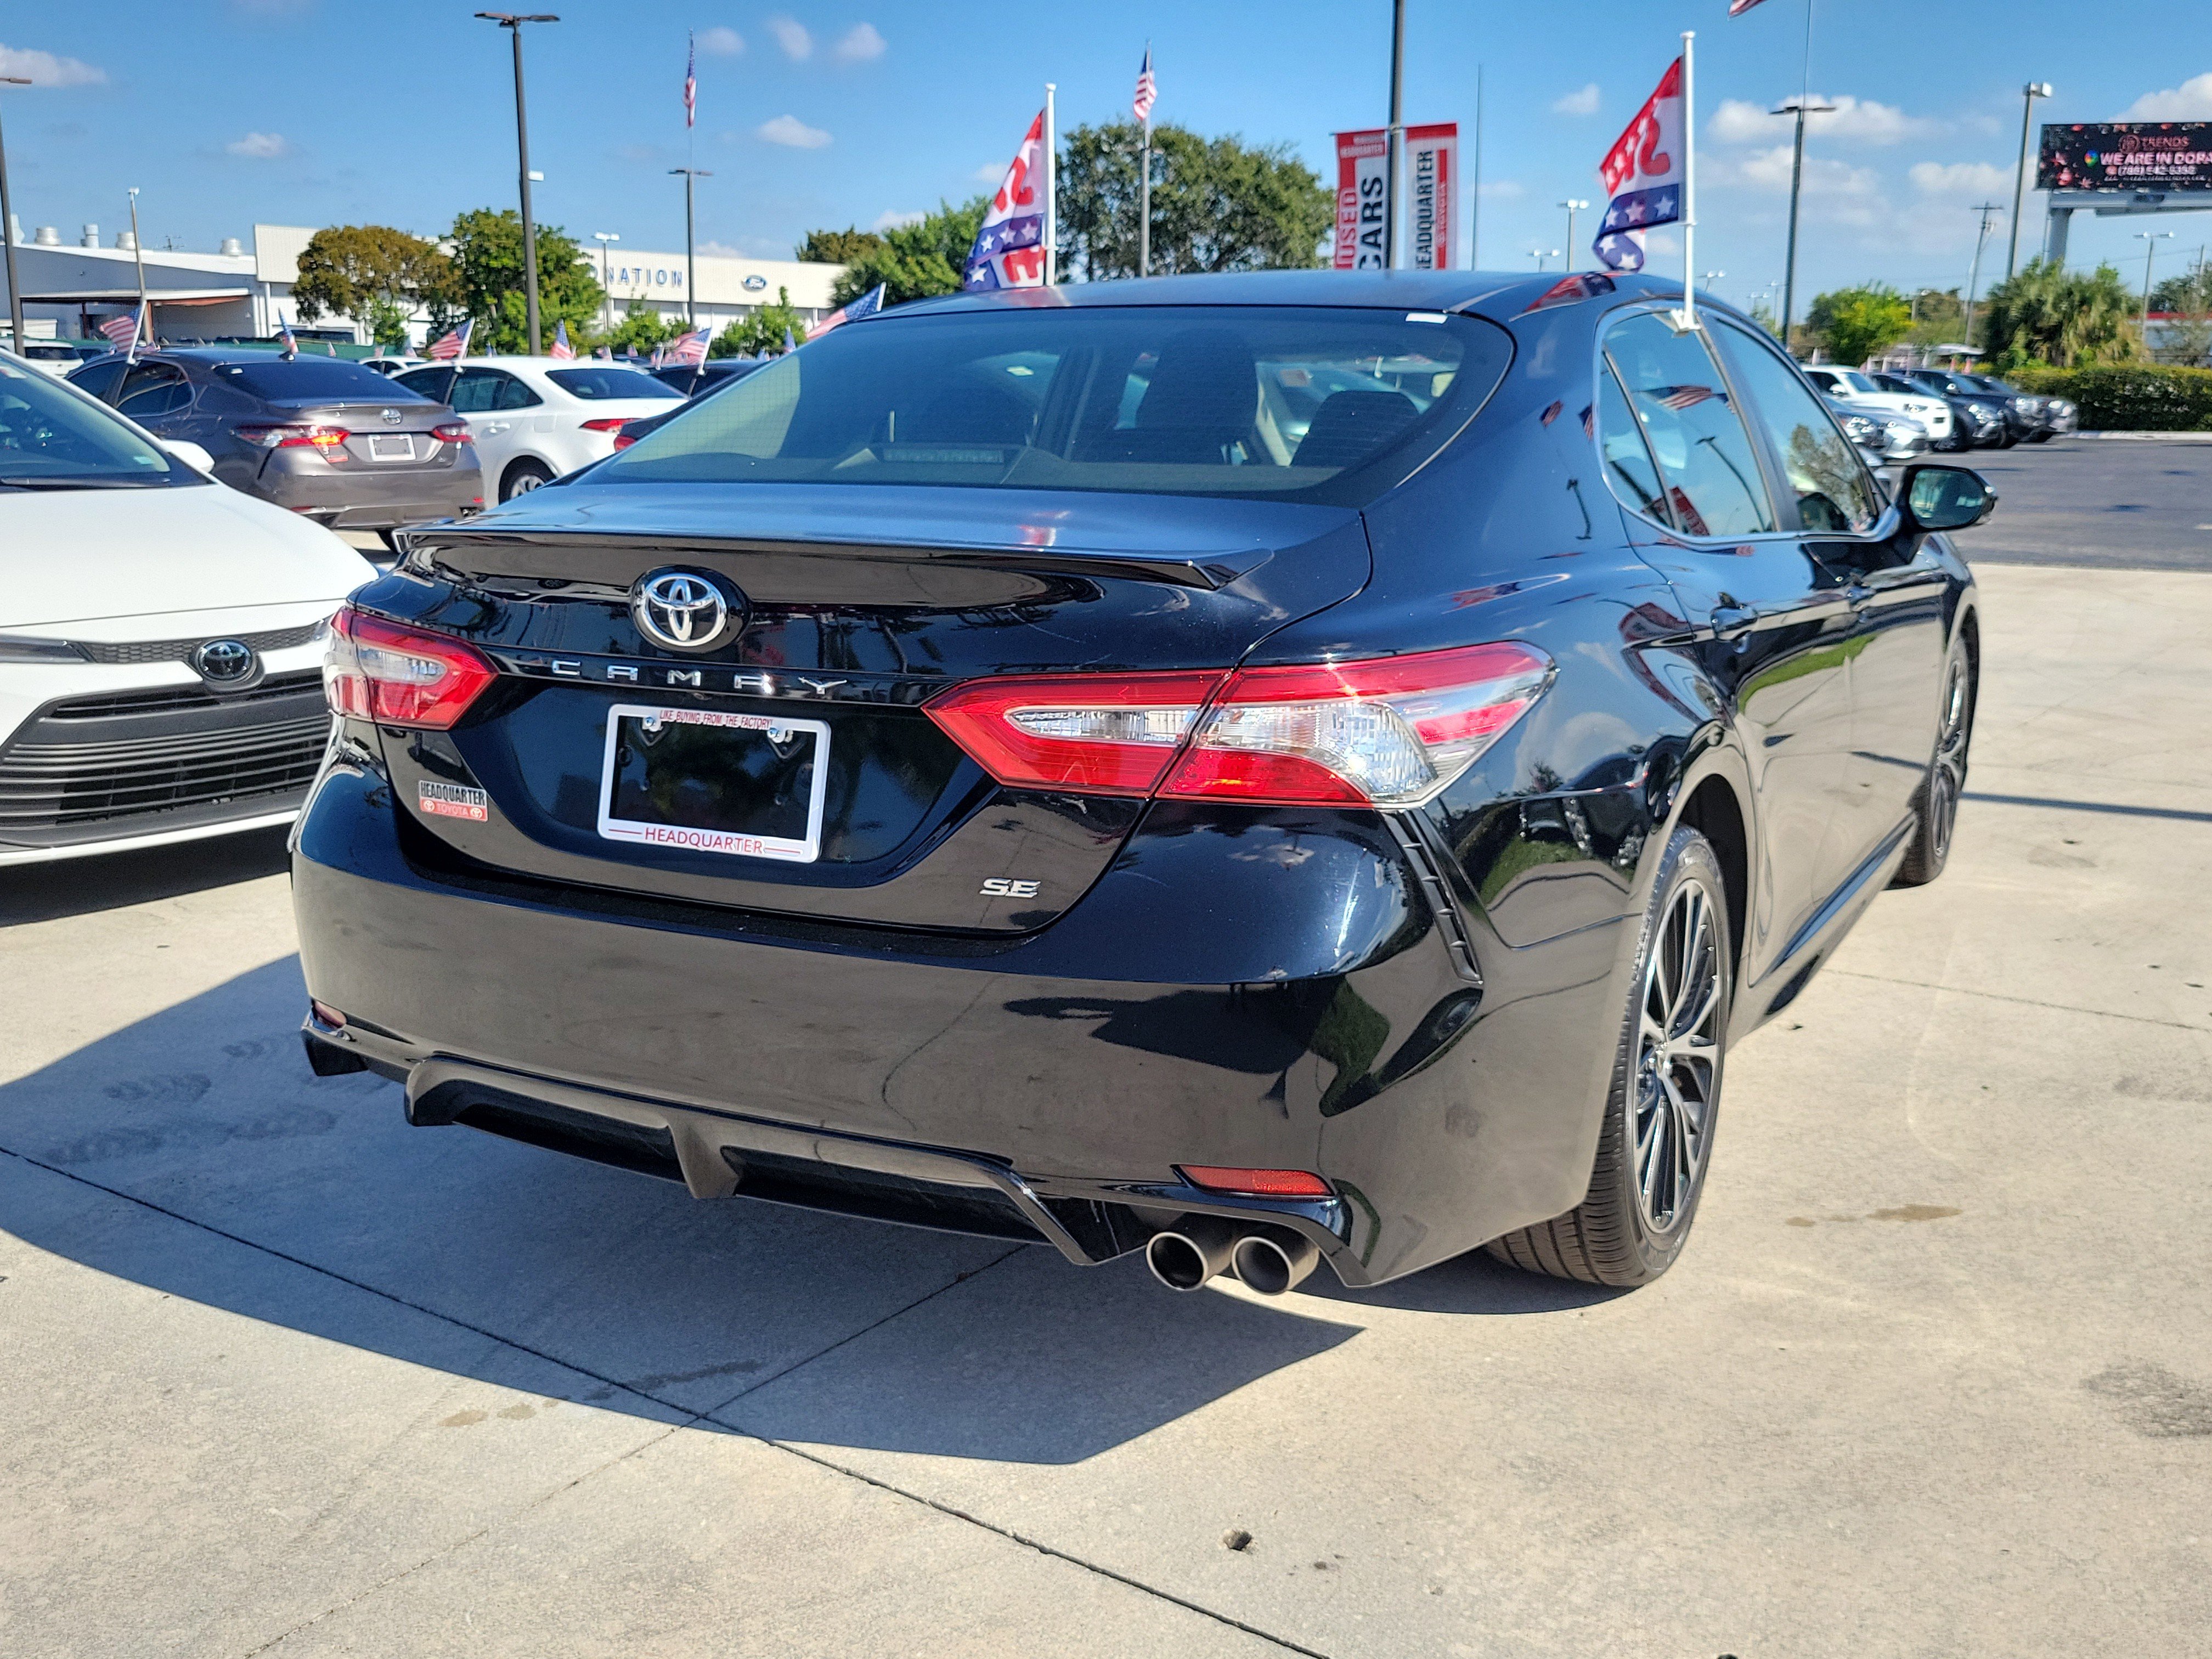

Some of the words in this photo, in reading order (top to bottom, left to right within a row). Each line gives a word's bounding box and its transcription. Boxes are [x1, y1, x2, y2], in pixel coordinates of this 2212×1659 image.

[2100, 153, 2124, 165] WE
[2124, 152, 2155, 165] ARE
[2156, 152, 2173, 165] IN
[1339, 192, 1357, 259] USED
[1359, 177, 1383, 269] CARS
[551, 659, 848, 695] CAMRY
[659, 710, 674, 720] LIKE
[676, 711, 700, 723] BUYING
[703, 713, 722, 724] FROM
[725, 715, 738, 726] THE
[420, 781, 486, 806] HEADQUARTER
[437, 803, 469, 816] TOYOTA
[645, 827, 763, 854] HEADQUARTER
[979, 877, 1041, 898] SE
